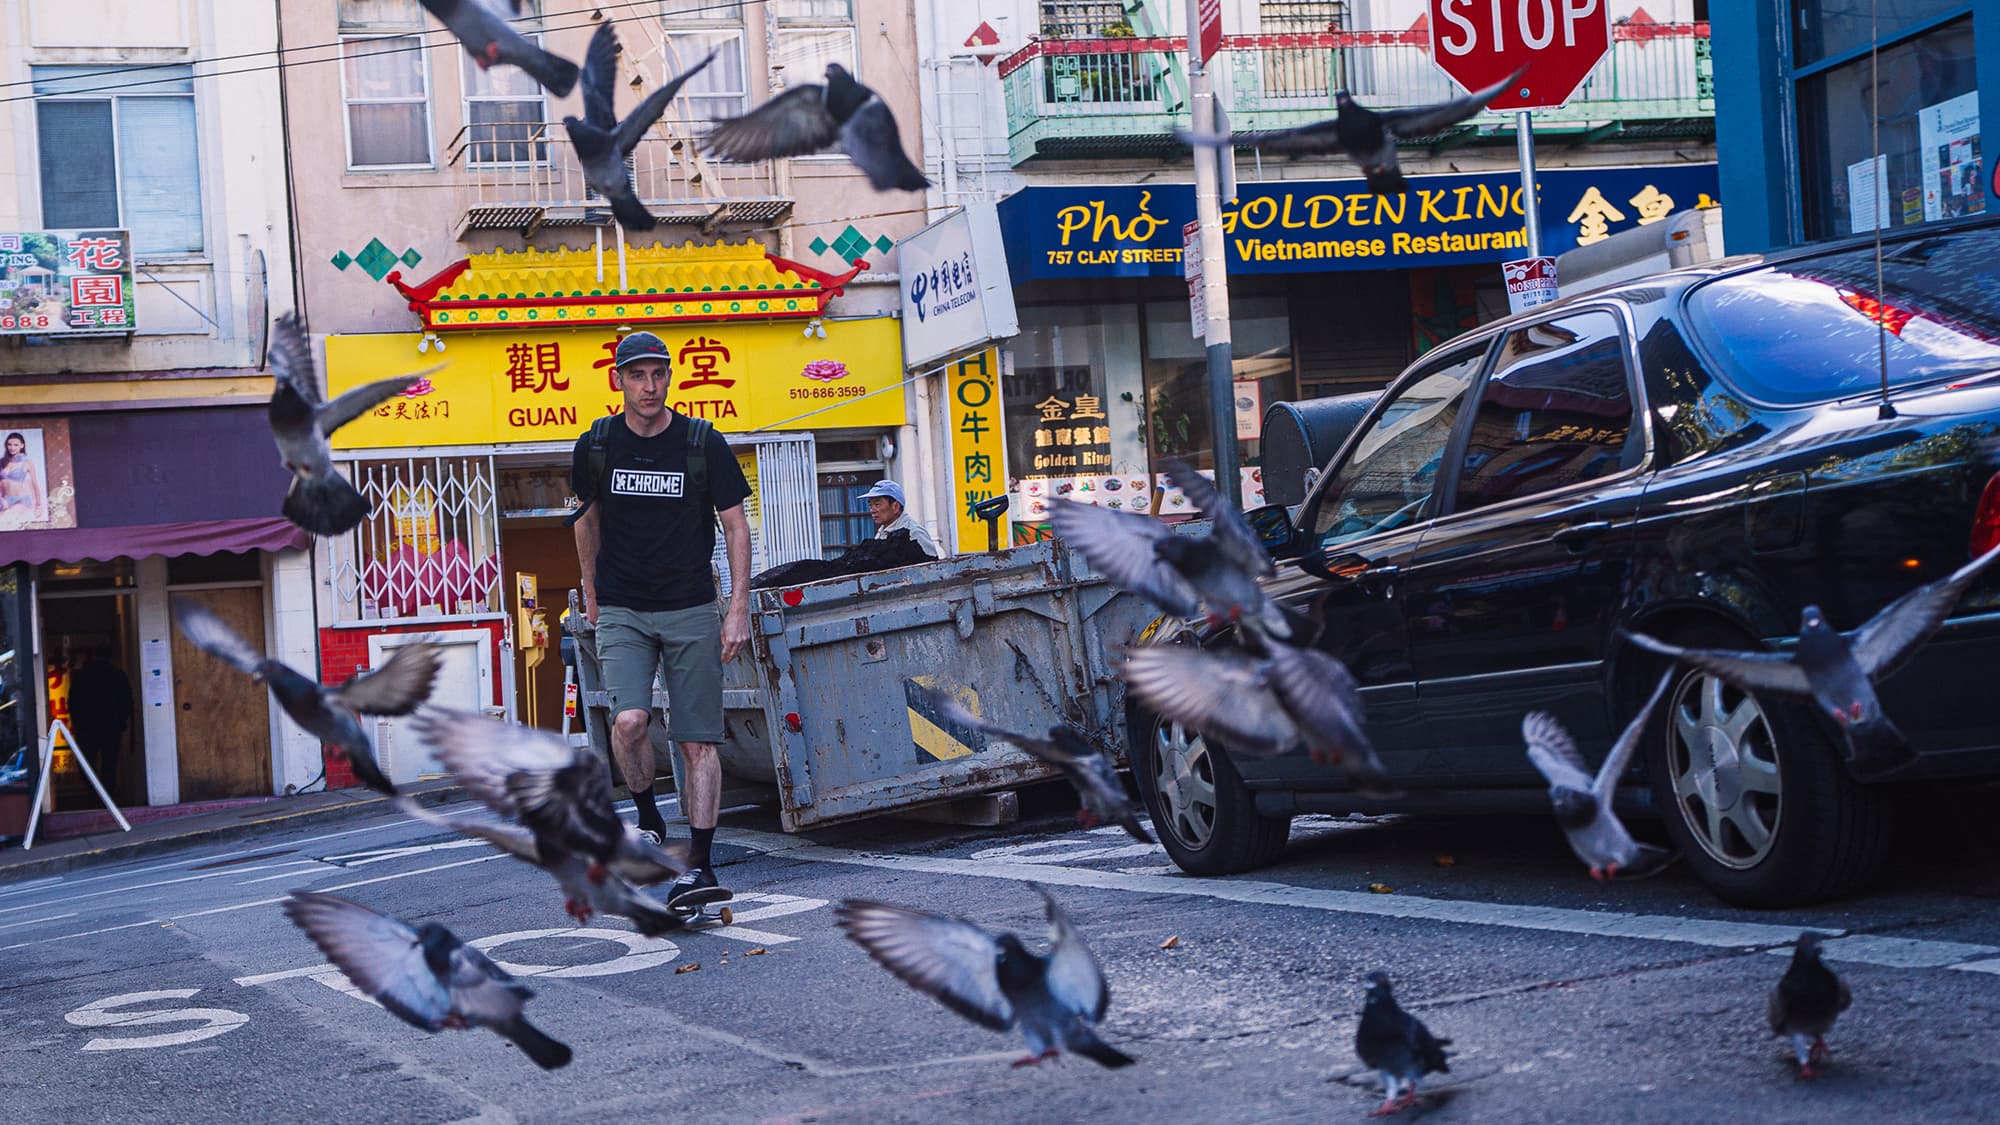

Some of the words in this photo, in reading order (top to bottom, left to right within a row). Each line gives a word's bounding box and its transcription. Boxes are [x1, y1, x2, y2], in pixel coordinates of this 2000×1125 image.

[1441, 0, 1598, 56] STOP
[1235, 238, 1386, 262] Vietnamese
[1392, 226, 1528, 255] Restaurant
[11, 254, 36, 265] INC.
[1047, 251, 1074, 265] 757
[1077, 250, 1119, 264] CLAY
[1121, 248, 1184, 264] STREET
[68, 239, 122, 306] 花園
[1510, 280, 1523, 293] NO
[71, 309, 125, 324] 工程
[508, 406, 577, 427] GUAN
[1035, 393, 1106, 423] 金皇
[1034, 453, 1077, 470] Golden
[626, 473, 680, 494] CHROME
